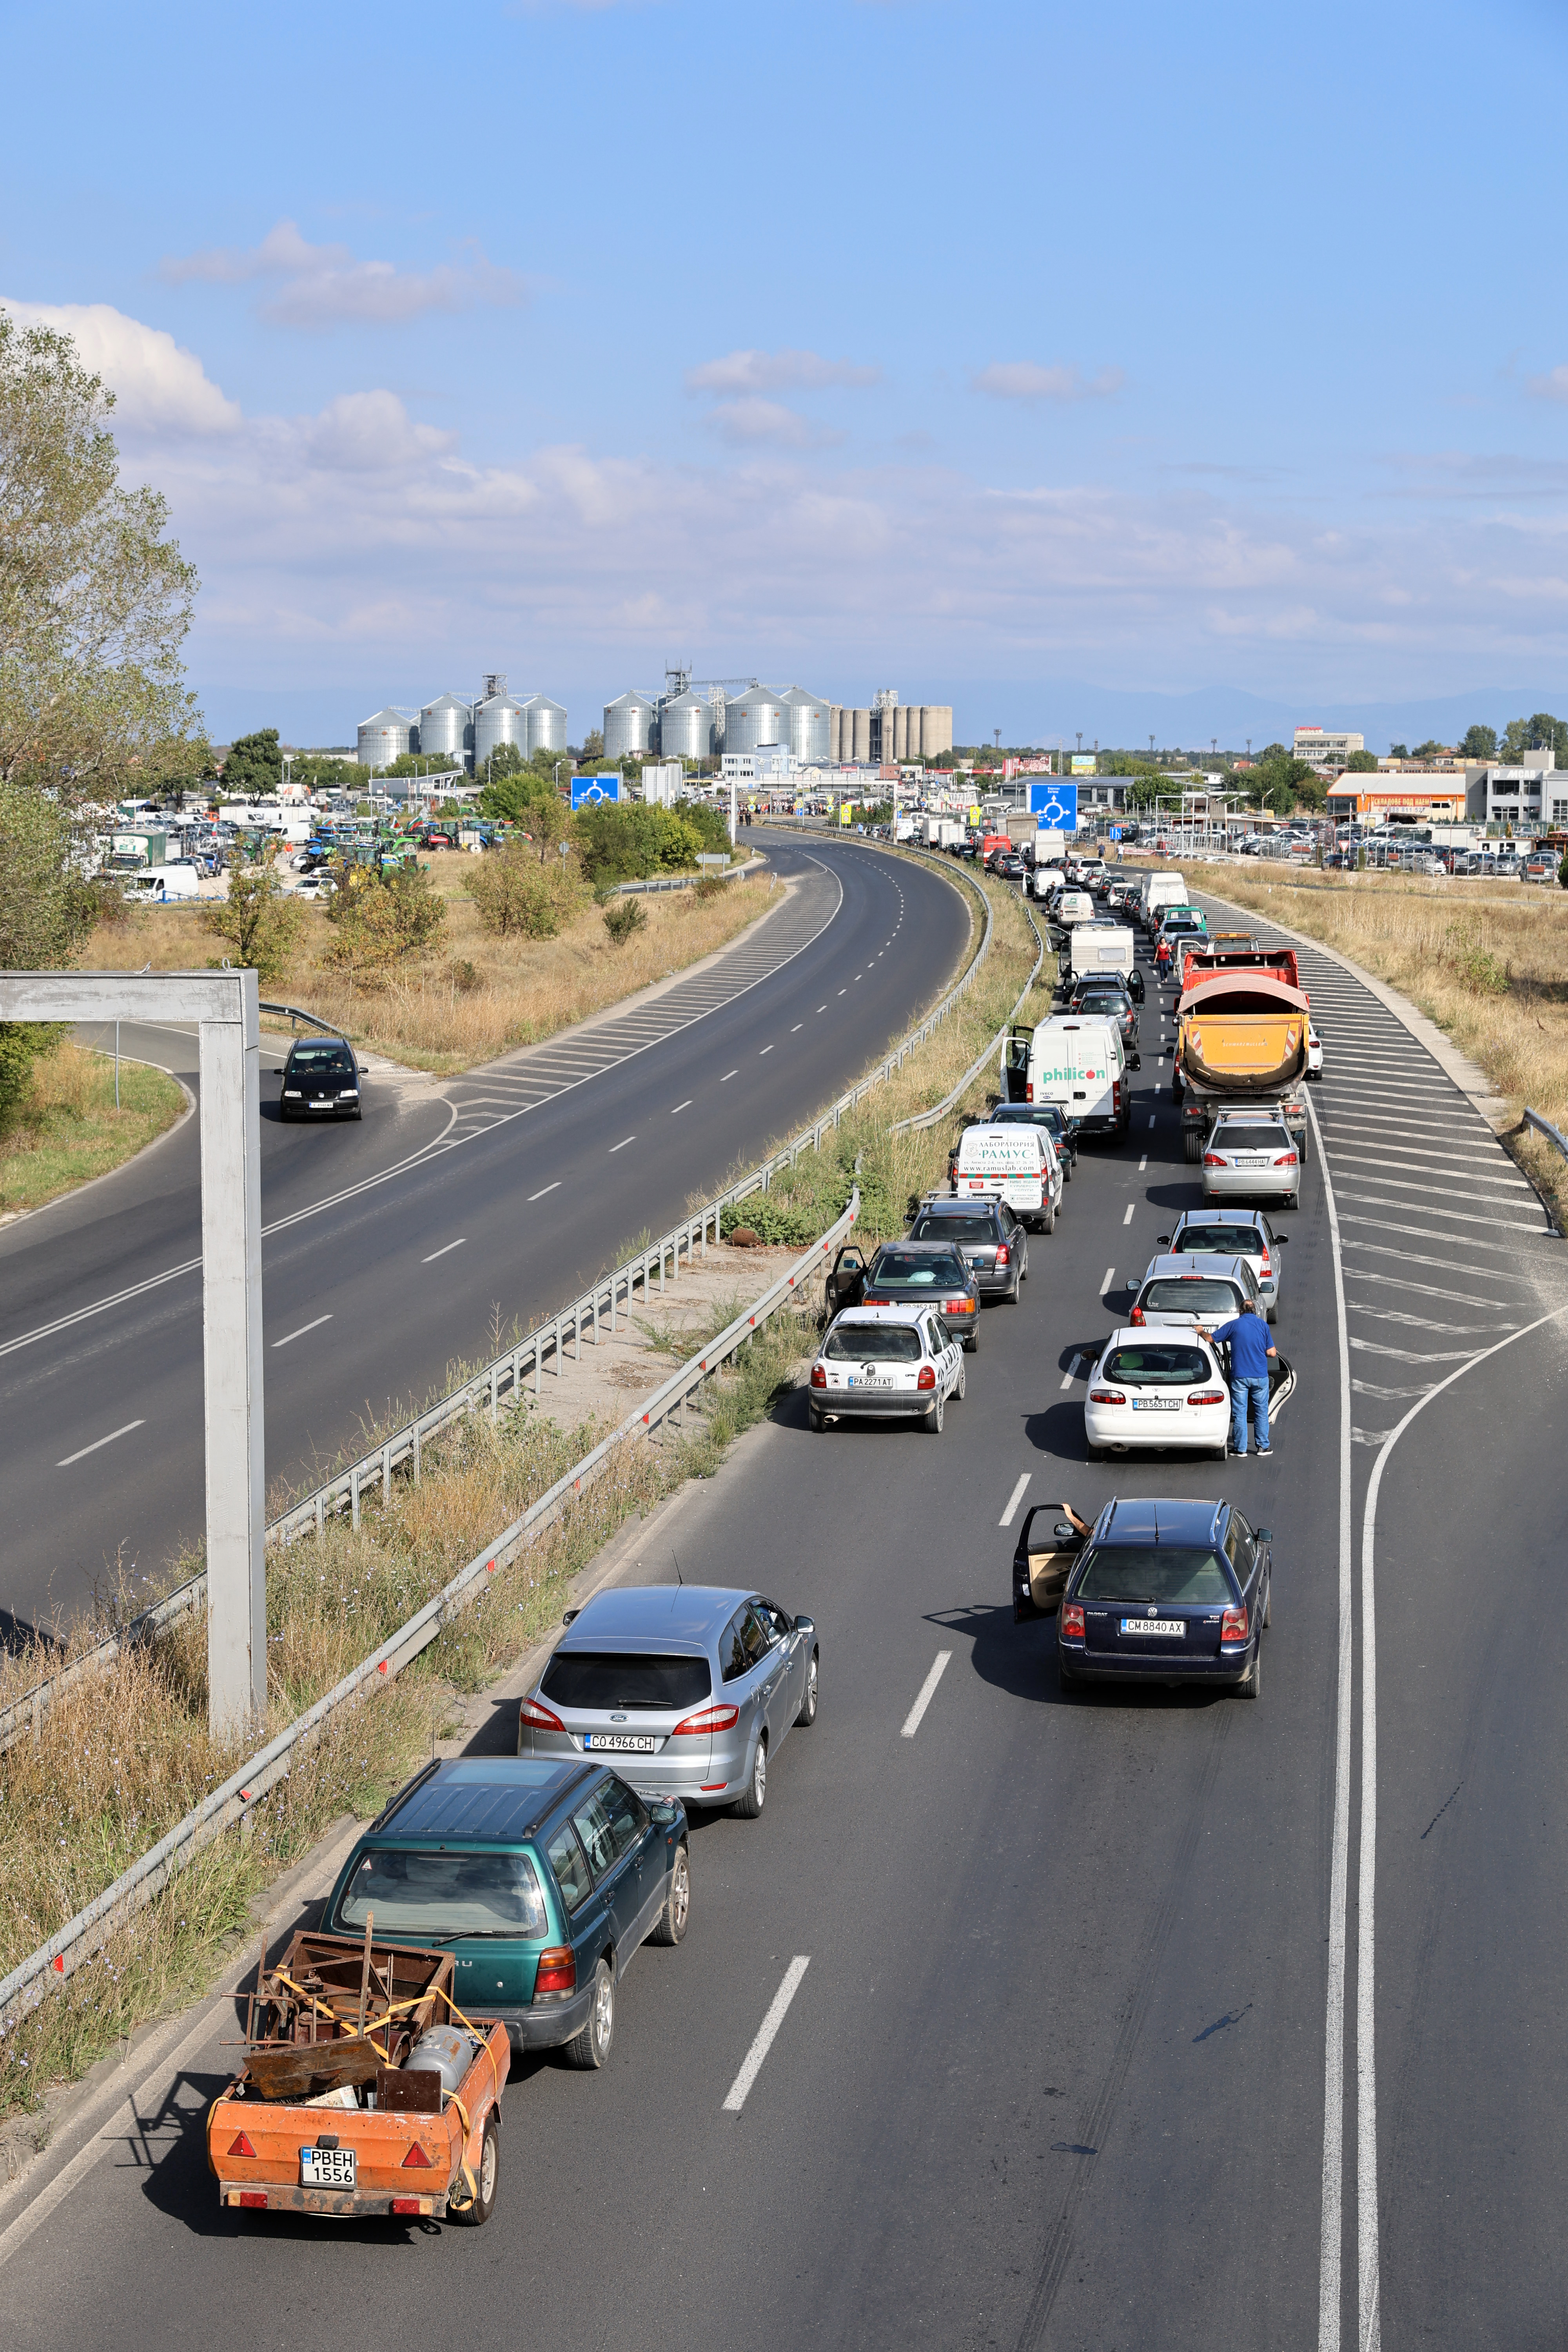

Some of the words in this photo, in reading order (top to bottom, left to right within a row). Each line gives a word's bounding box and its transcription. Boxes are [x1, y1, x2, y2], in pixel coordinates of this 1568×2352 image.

[982, 1149, 1030, 1159] РАМУС
[1128, 1621, 1141, 1631] CM
[1143, 1622, 1167, 1632] 8840
[1169, 1622, 1181, 1632] AX
[592, 1735, 606, 1747] CO
[608, 1736, 635, 1748] 4966
[637, 1737, 652, 1749] CH
[312, 2151, 352, 2167] PBEH
[314, 2167, 352, 2183] 1556
